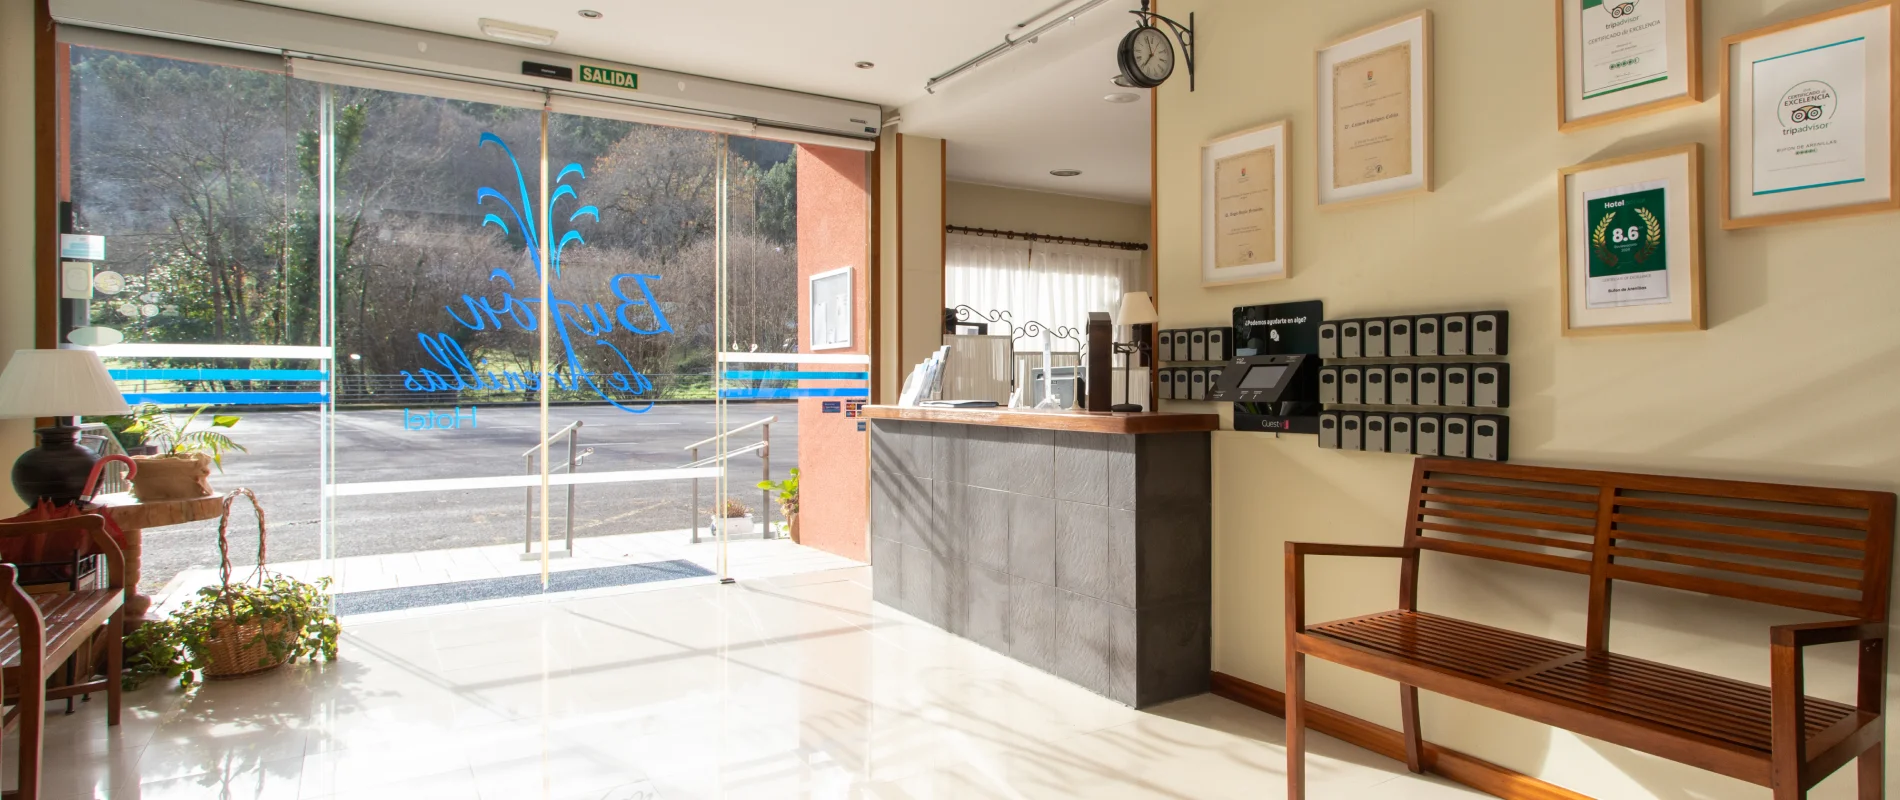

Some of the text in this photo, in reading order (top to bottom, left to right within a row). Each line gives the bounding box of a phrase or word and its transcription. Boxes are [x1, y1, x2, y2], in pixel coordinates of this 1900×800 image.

[1605, 16, 1640, 30] tripadvisor
[1587, 31, 1621, 45] CERTIFICADO
[1629, 19, 1661, 34] EXCELENCIA
[583, 67, 635, 88] SALIDA
[1784, 93, 1830, 107] EXCELENCIA
[1787, 90, 1821, 100] CERTIFICADO
[1782, 122, 1829, 136] tripadvisor
[1604, 199, 1625, 209] Hotel
[1612, 226, 1639, 243] 8.6
